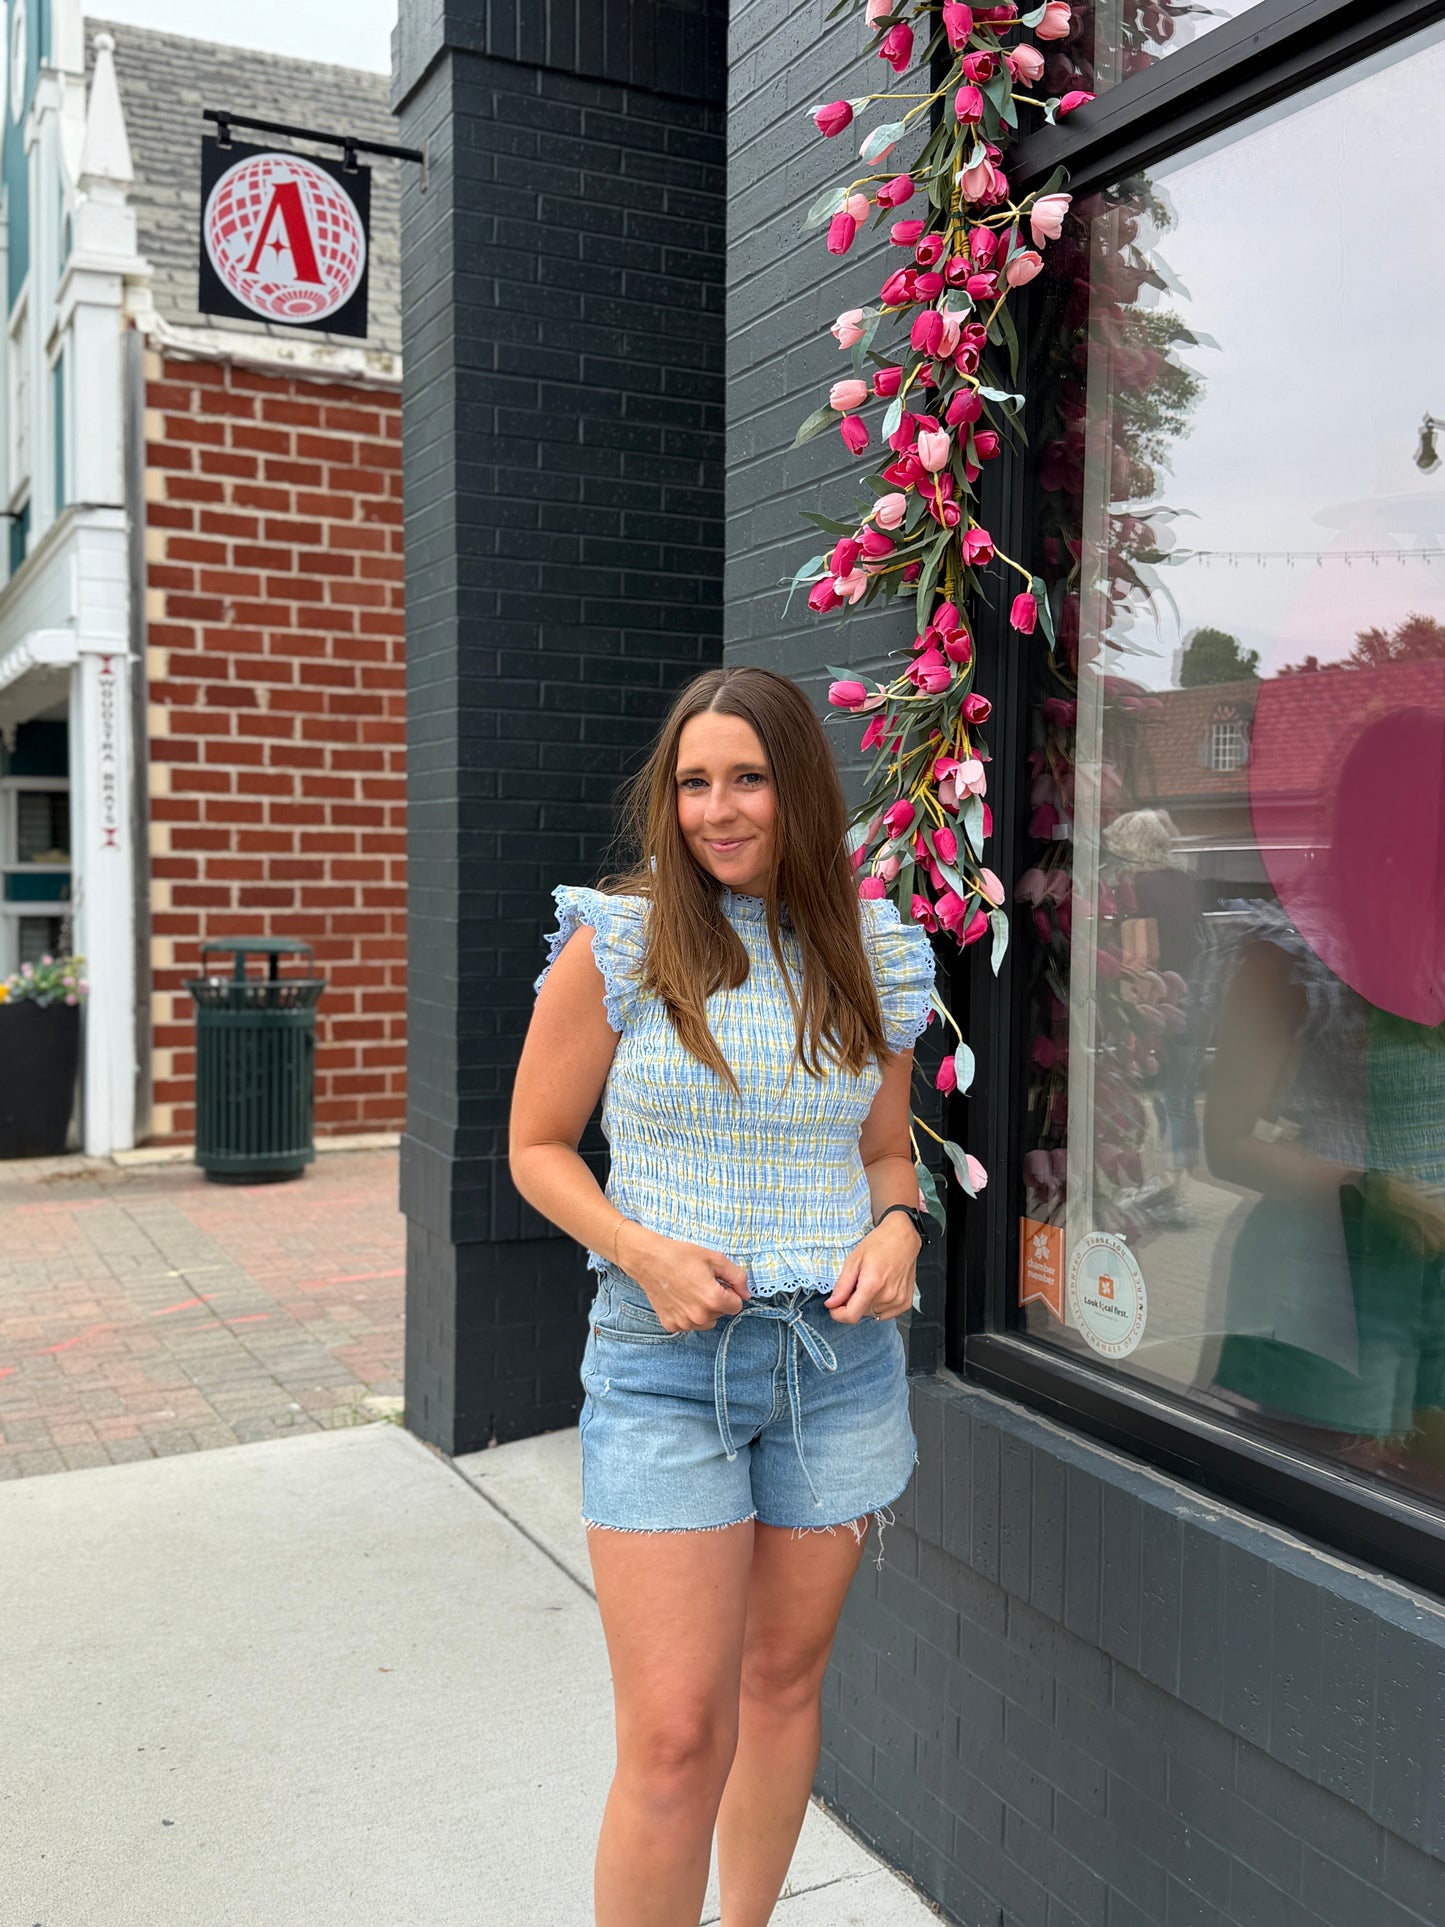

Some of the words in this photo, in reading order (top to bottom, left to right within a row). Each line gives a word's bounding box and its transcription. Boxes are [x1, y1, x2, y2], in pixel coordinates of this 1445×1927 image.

[242, 181, 326, 286] A
[1086, 1237, 1110, 1247] THANK
[1111, 1242, 1126, 1256] YOU
[1027, 1258, 1055, 1275] chamber
[1071, 1252, 1082, 1296] ORANGE
[1027, 1270, 1055, 1286] member
[1072, 1302, 1085, 1328] CITY
[1084, 1296, 1098, 1307] Look
[1114, 1306, 1128, 1318] first.
[1086, 1331, 1121, 1354] CHAMBER
[1124, 1338, 1133, 1348] OF
